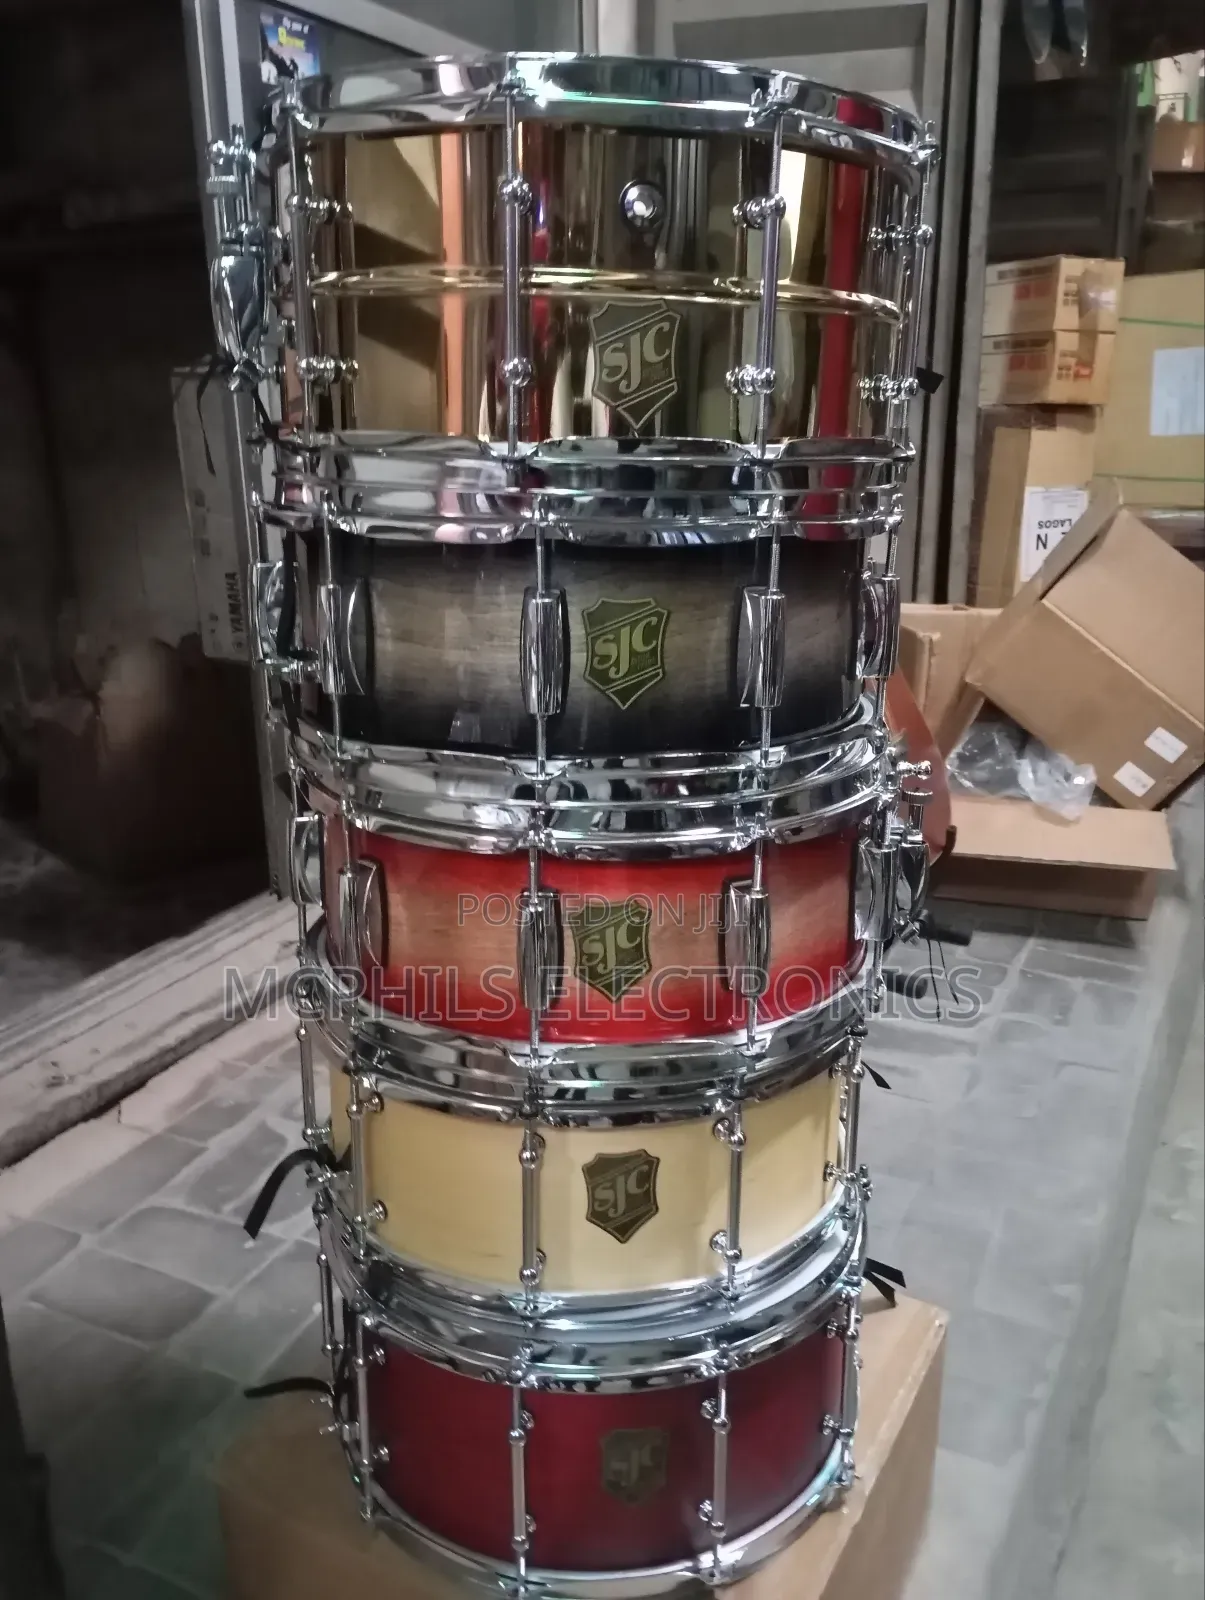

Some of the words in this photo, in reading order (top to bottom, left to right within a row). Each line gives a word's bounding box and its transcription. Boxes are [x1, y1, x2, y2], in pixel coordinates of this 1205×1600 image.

[601, 321, 671, 394] SJC
[1037, 518, 1072, 530] LAGOS
[224, 571, 244, 634] YAMAHA
[592, 616, 658, 679] SJC
[582, 915, 641, 975] SJC
[593, 1164, 649, 1218] SJC
